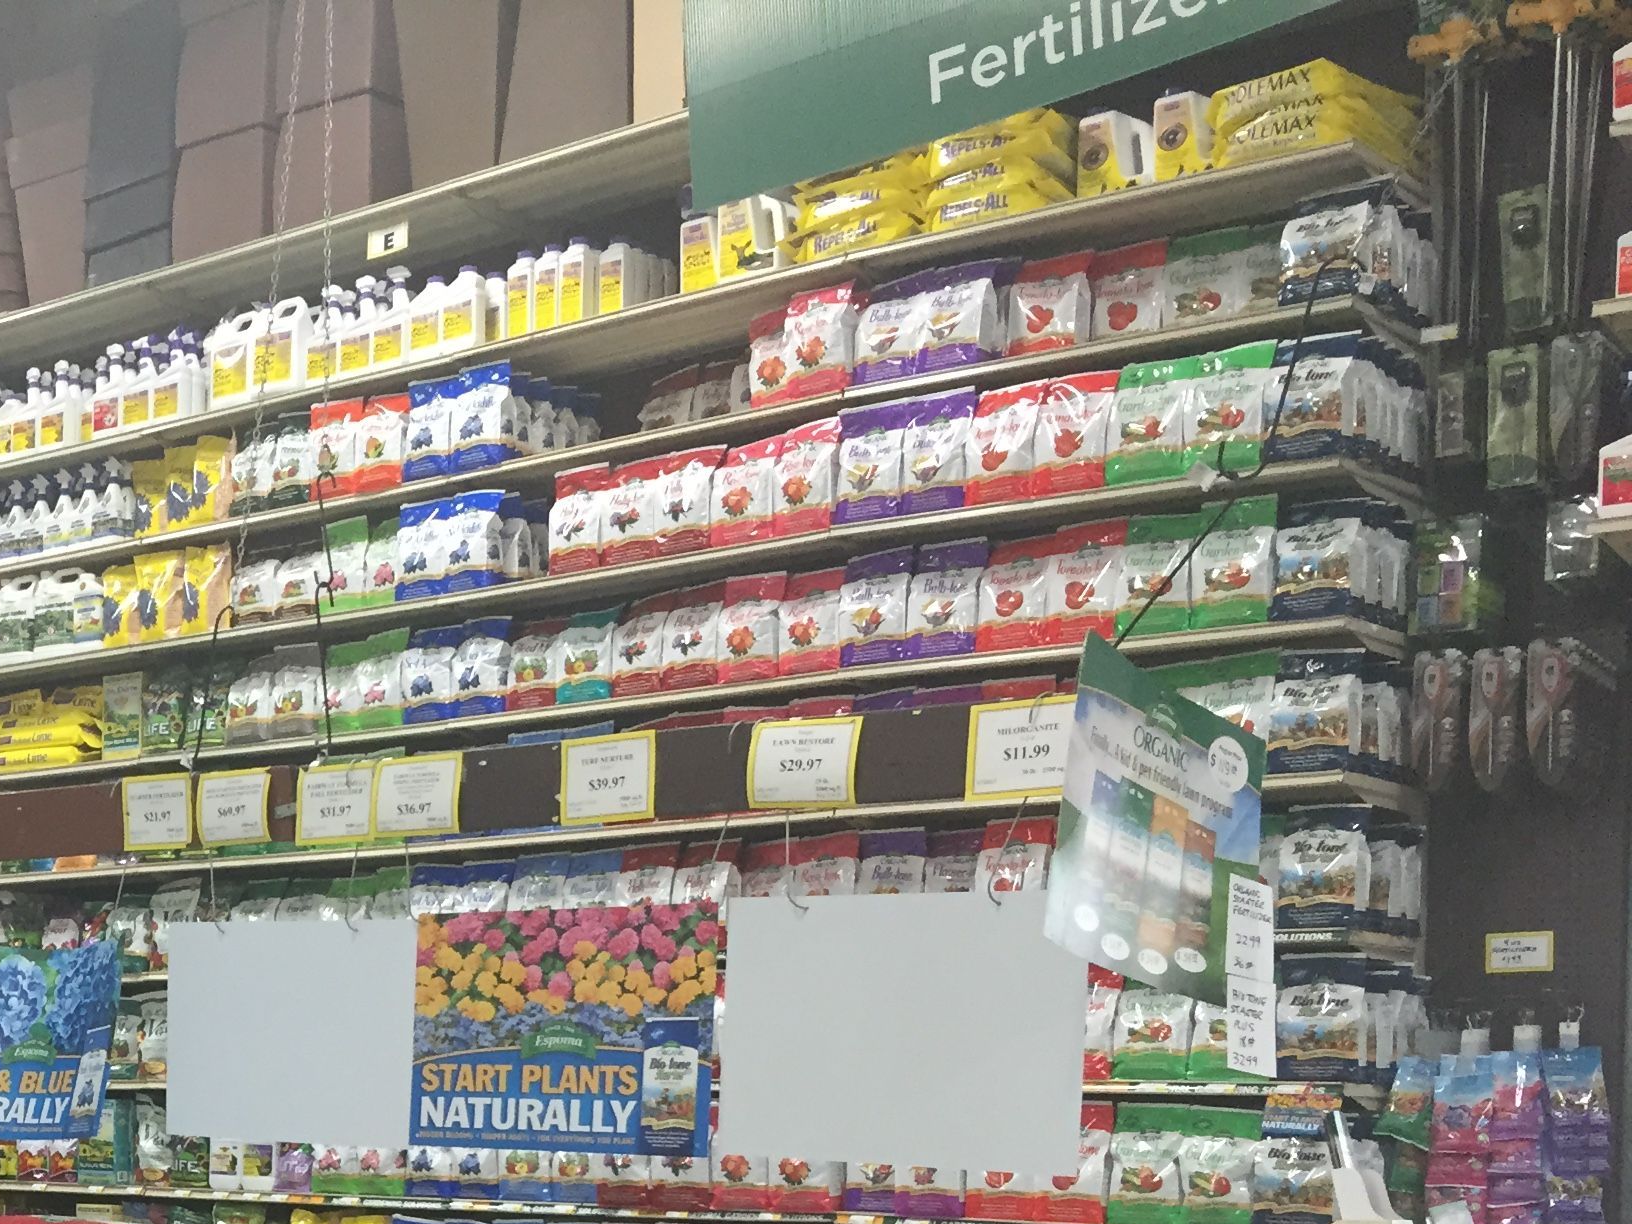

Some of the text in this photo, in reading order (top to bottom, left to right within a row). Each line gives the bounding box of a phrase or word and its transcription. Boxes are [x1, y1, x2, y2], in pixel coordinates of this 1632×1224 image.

[928, 0, 1226, 105] Fertiliz
[383, 231, 396, 252] E
[1003, 743, 1051, 761] $11.99
[1134, 725, 1189, 772] ORGANIC
[779, 759, 823, 773] $29.97
[588, 776, 627, 791] $39.97
[397, 801, 432, 816] $36.97
[534, 1034, 583, 1049] Espoma
[18, 1066, 76, 1096] BLUE
[421, 1062, 639, 1096] START PLANTS
[419, 1096, 638, 1133] NATURALLY
